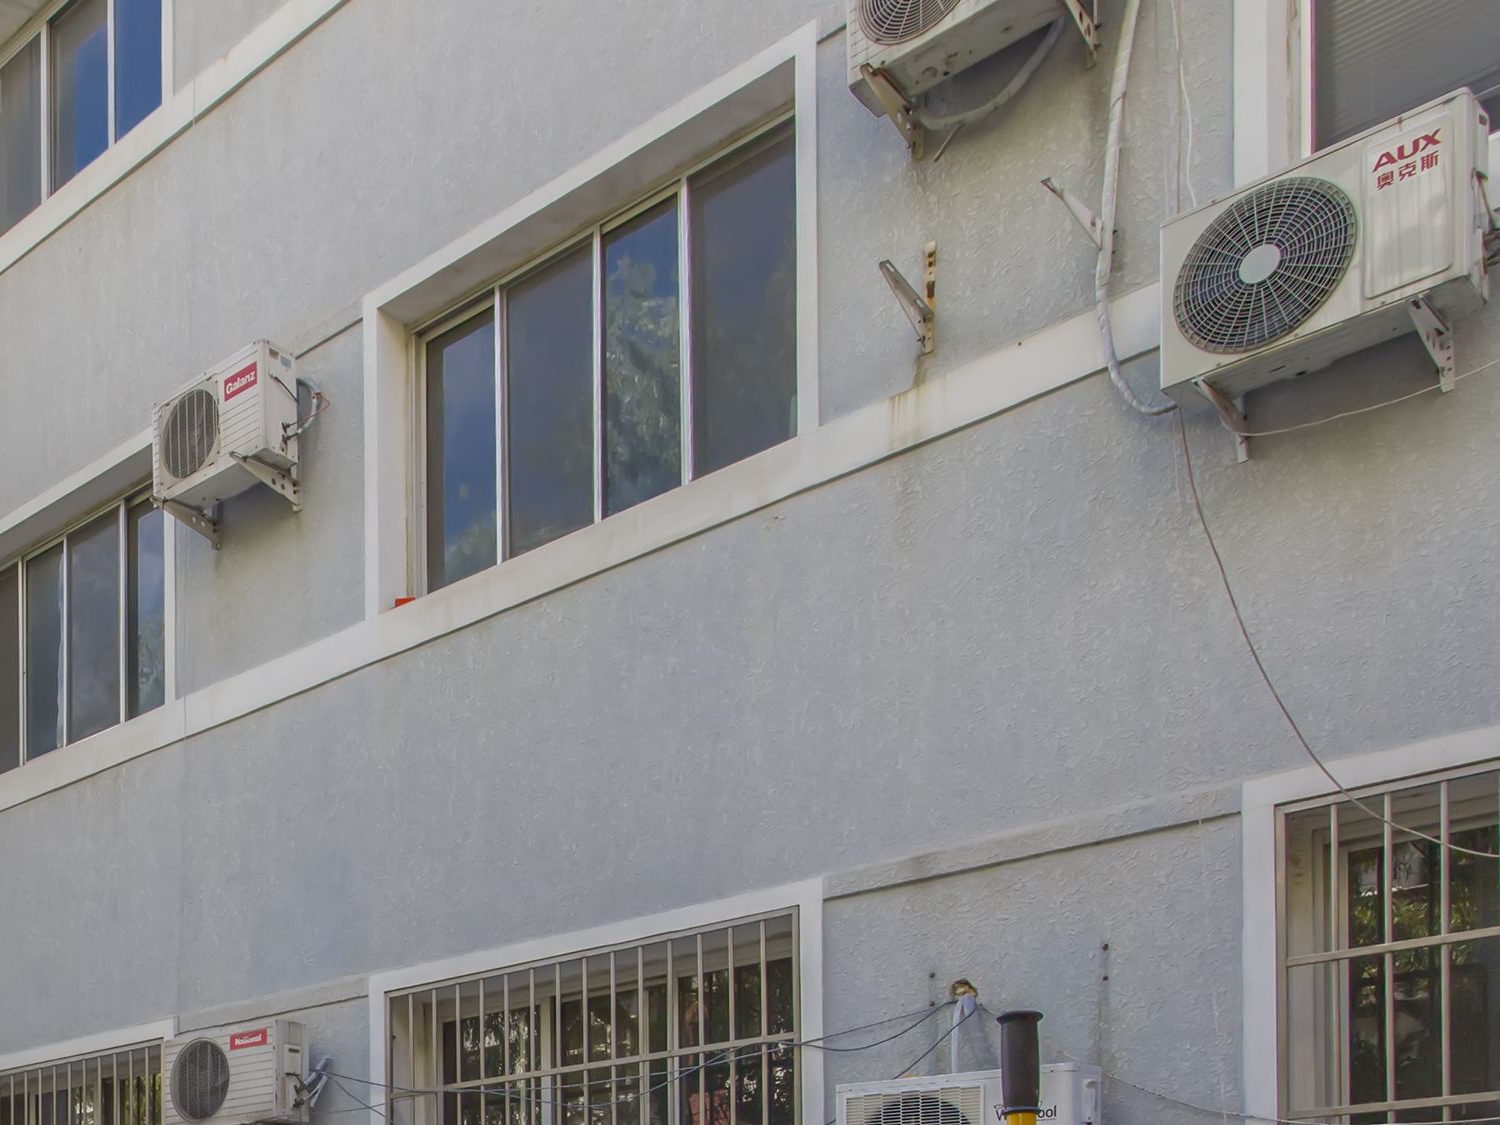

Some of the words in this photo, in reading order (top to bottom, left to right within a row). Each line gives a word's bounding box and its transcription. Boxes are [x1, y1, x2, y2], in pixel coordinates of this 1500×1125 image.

[1373, 128, 1442, 173] AUX
[1377, 150, 1439, 190] 奥克斯
[226, 371, 256, 394] Galanz
